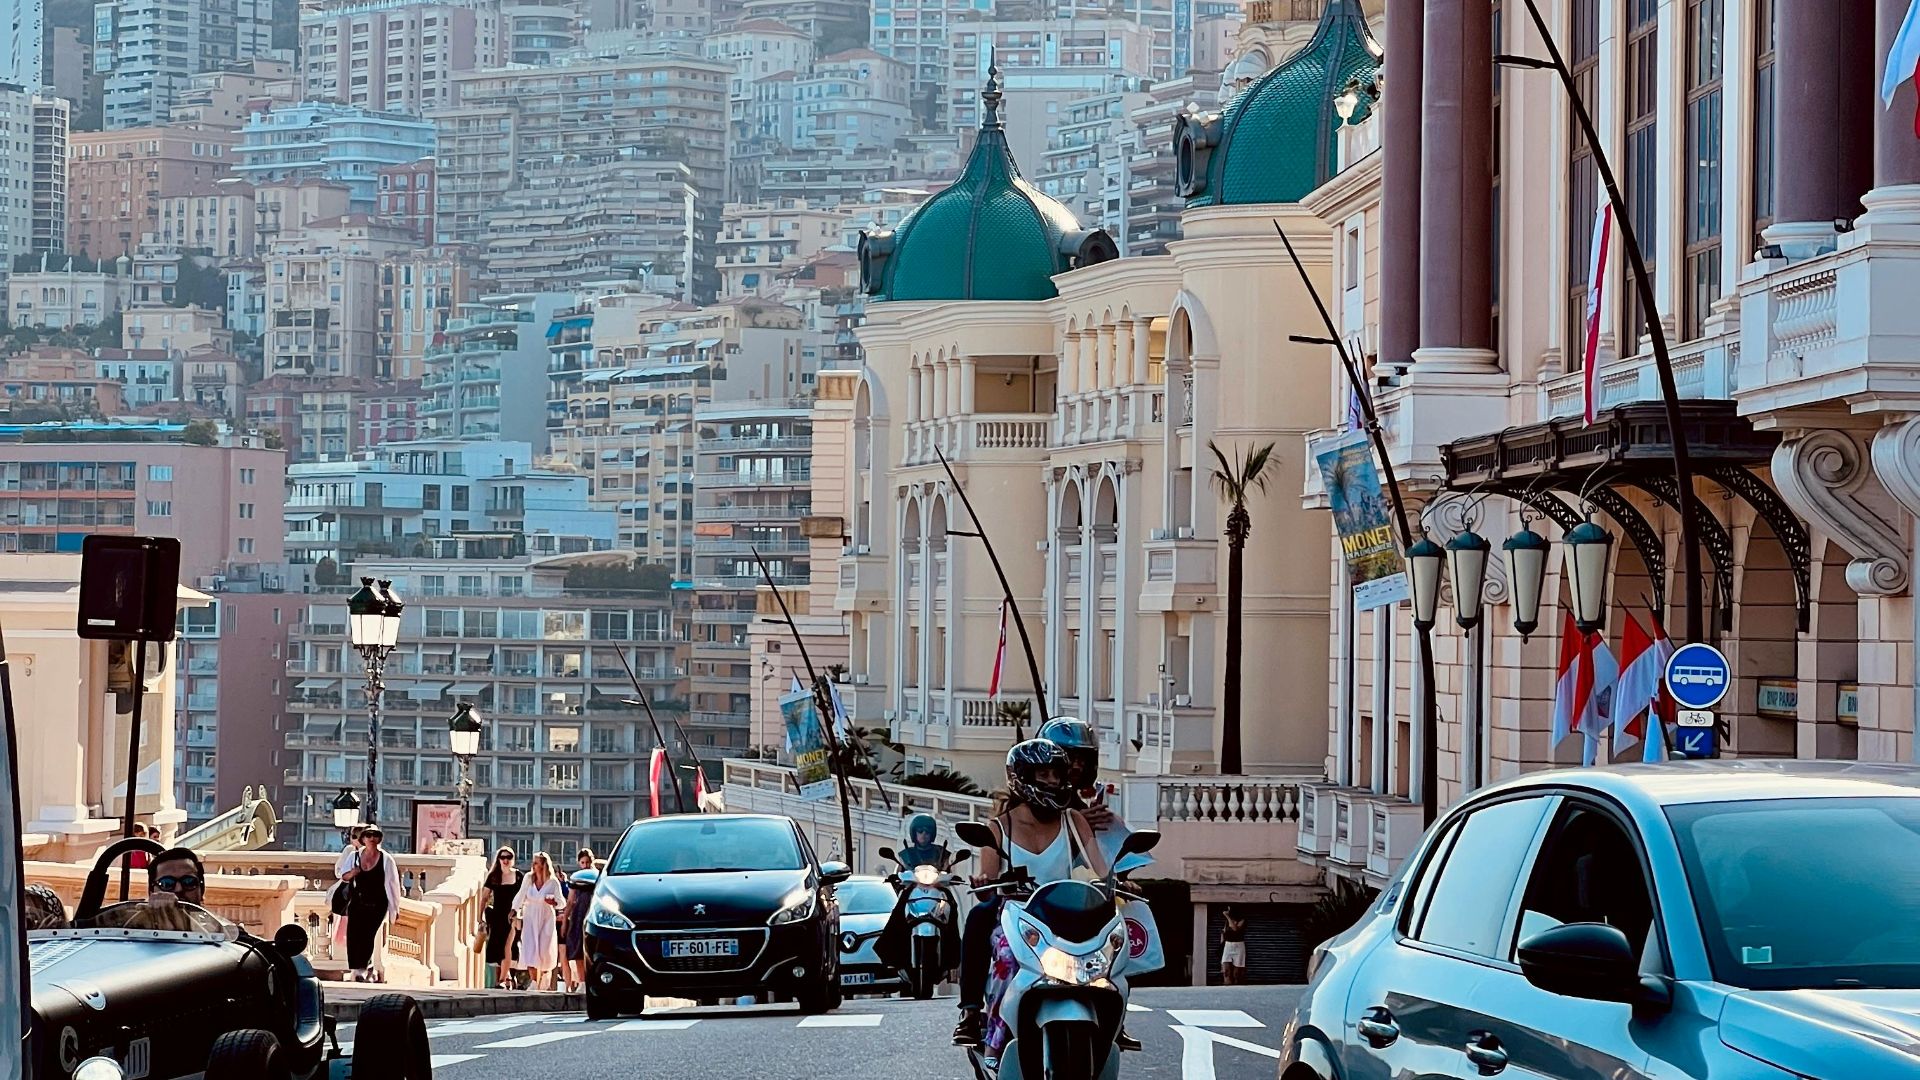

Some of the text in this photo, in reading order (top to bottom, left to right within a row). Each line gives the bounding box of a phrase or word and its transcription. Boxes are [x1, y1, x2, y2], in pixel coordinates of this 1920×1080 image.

[1342, 525, 1392, 554] MONET
[1767, 691, 1778, 706] BNP
[797, 748, 828, 765] MONET
[670, 940, 730, 955] FF-601-FE
